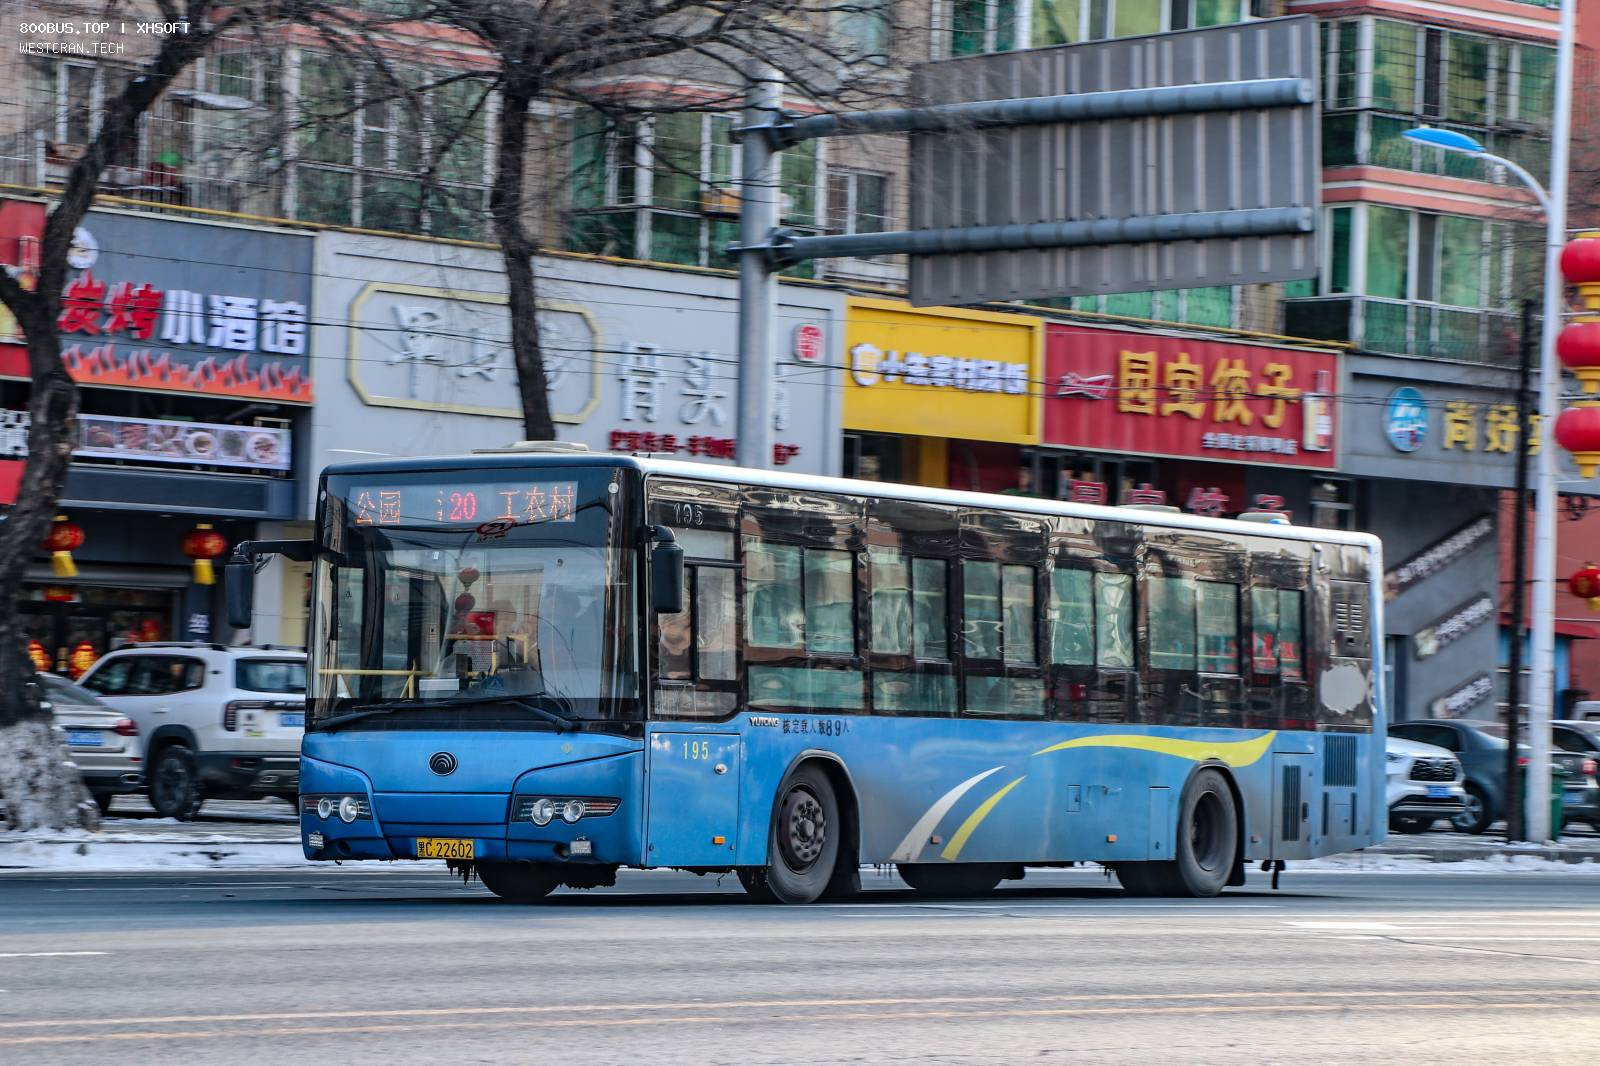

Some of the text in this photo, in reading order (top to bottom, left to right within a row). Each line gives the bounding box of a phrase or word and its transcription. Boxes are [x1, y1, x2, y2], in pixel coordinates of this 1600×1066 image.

[57, 269, 307, 355] 炭烤小酒馆
[1118, 349, 1301, 429] 园宝饺子
[356, 490, 401, 523] 公园
[497, 485, 575, 523] 工农村
[673, 502, 704, 526] 195
[749, 716, 779, 728] YUTONG
[683, 741, 709, 760] 195
